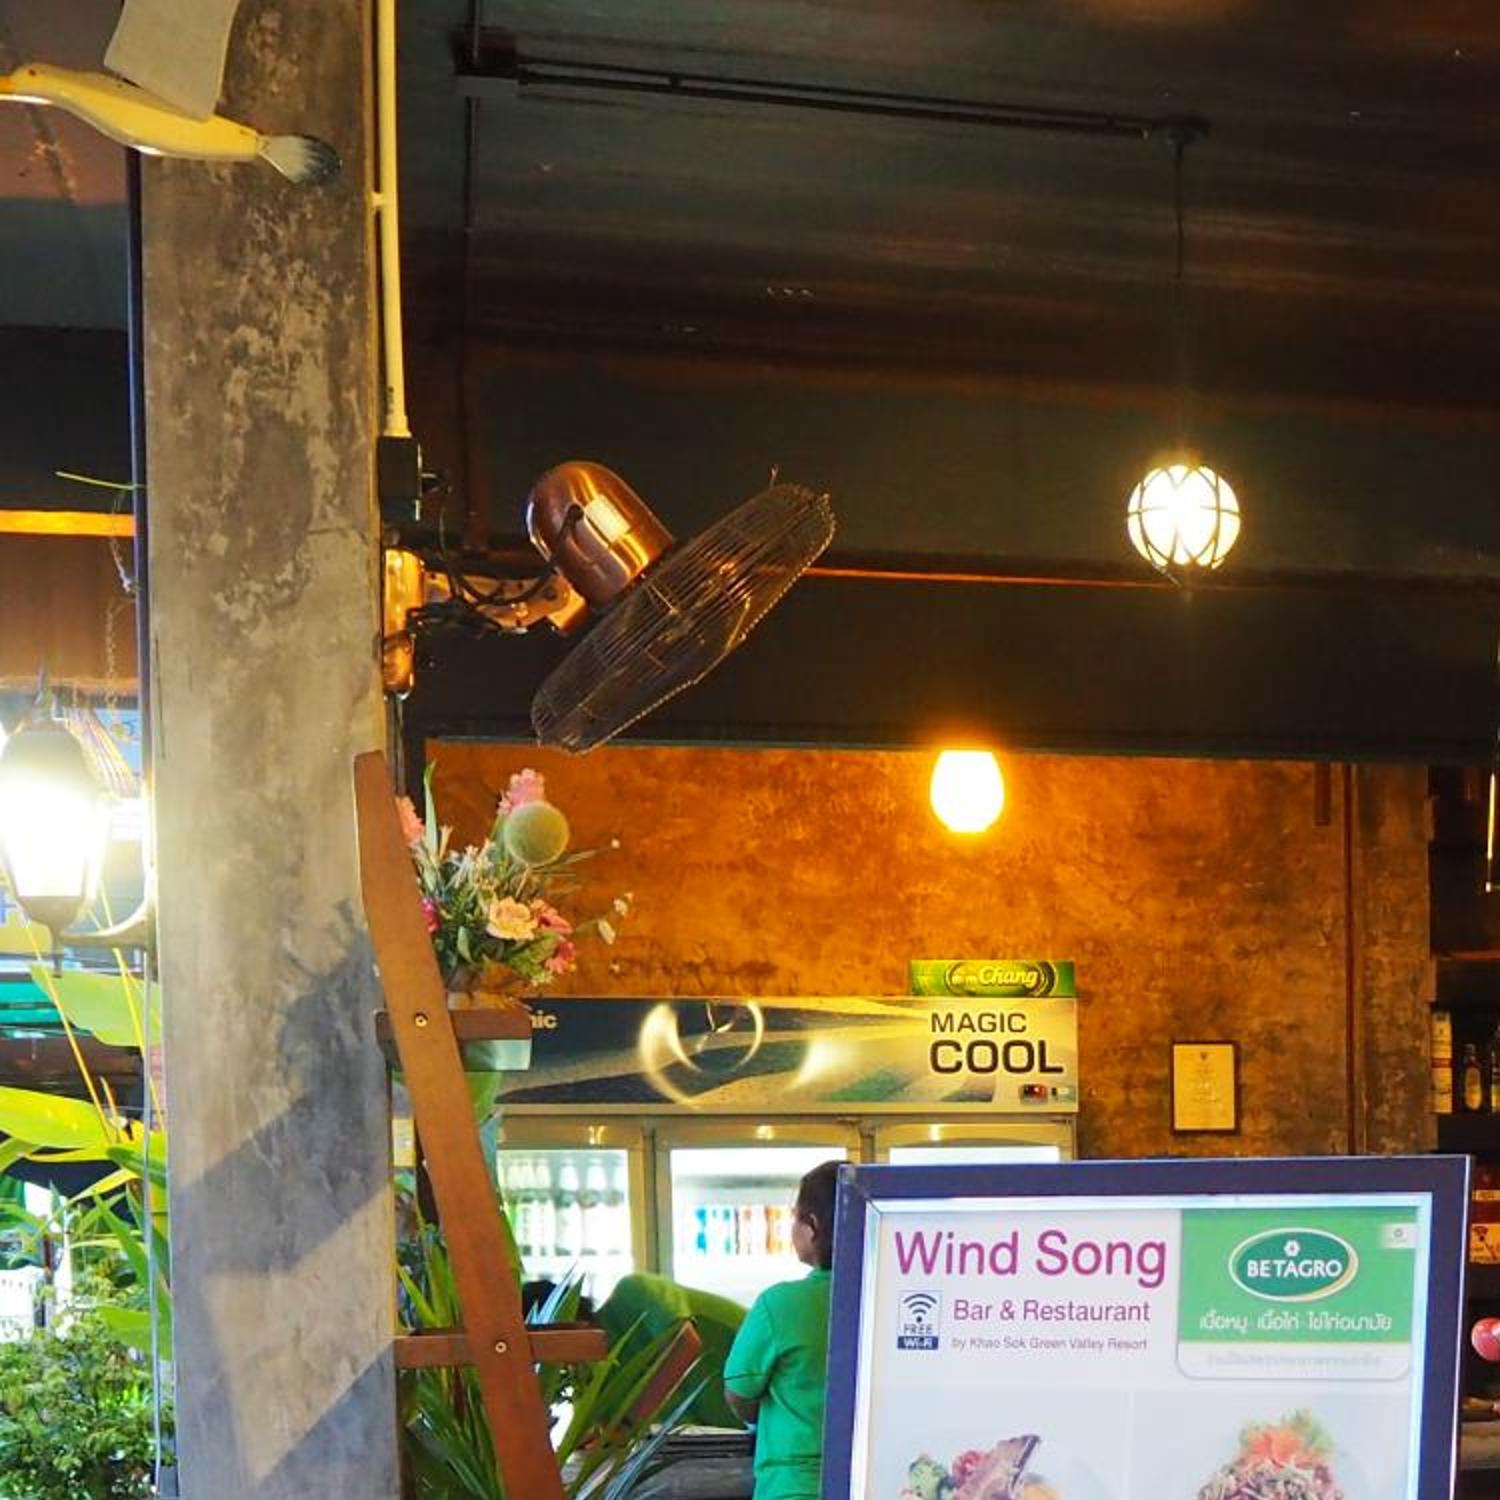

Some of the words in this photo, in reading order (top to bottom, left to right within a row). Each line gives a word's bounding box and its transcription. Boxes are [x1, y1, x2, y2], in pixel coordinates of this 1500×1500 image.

[979, 966, 1038, 988] Chang
[931, 1012, 1027, 1032] MAGIC
[930, 1039, 1064, 1074] COOL
[895, 1231, 1019, 1276] Wind
[1036, 1230, 1167, 1289] Song
[1247, 1260, 1343, 1278] BETAGRO
[953, 1299, 993, 1321] Bar
[1000, 1299, 1016, 1321] &
[1022, 1299, 1151, 1322] Restaurant
[903, 1323, 935, 1335] FREE
[951, 1337, 967, 1351] by
[1029, 1337, 1067, 1349] Green
[1108, 1337, 1148, 1350] Resort
